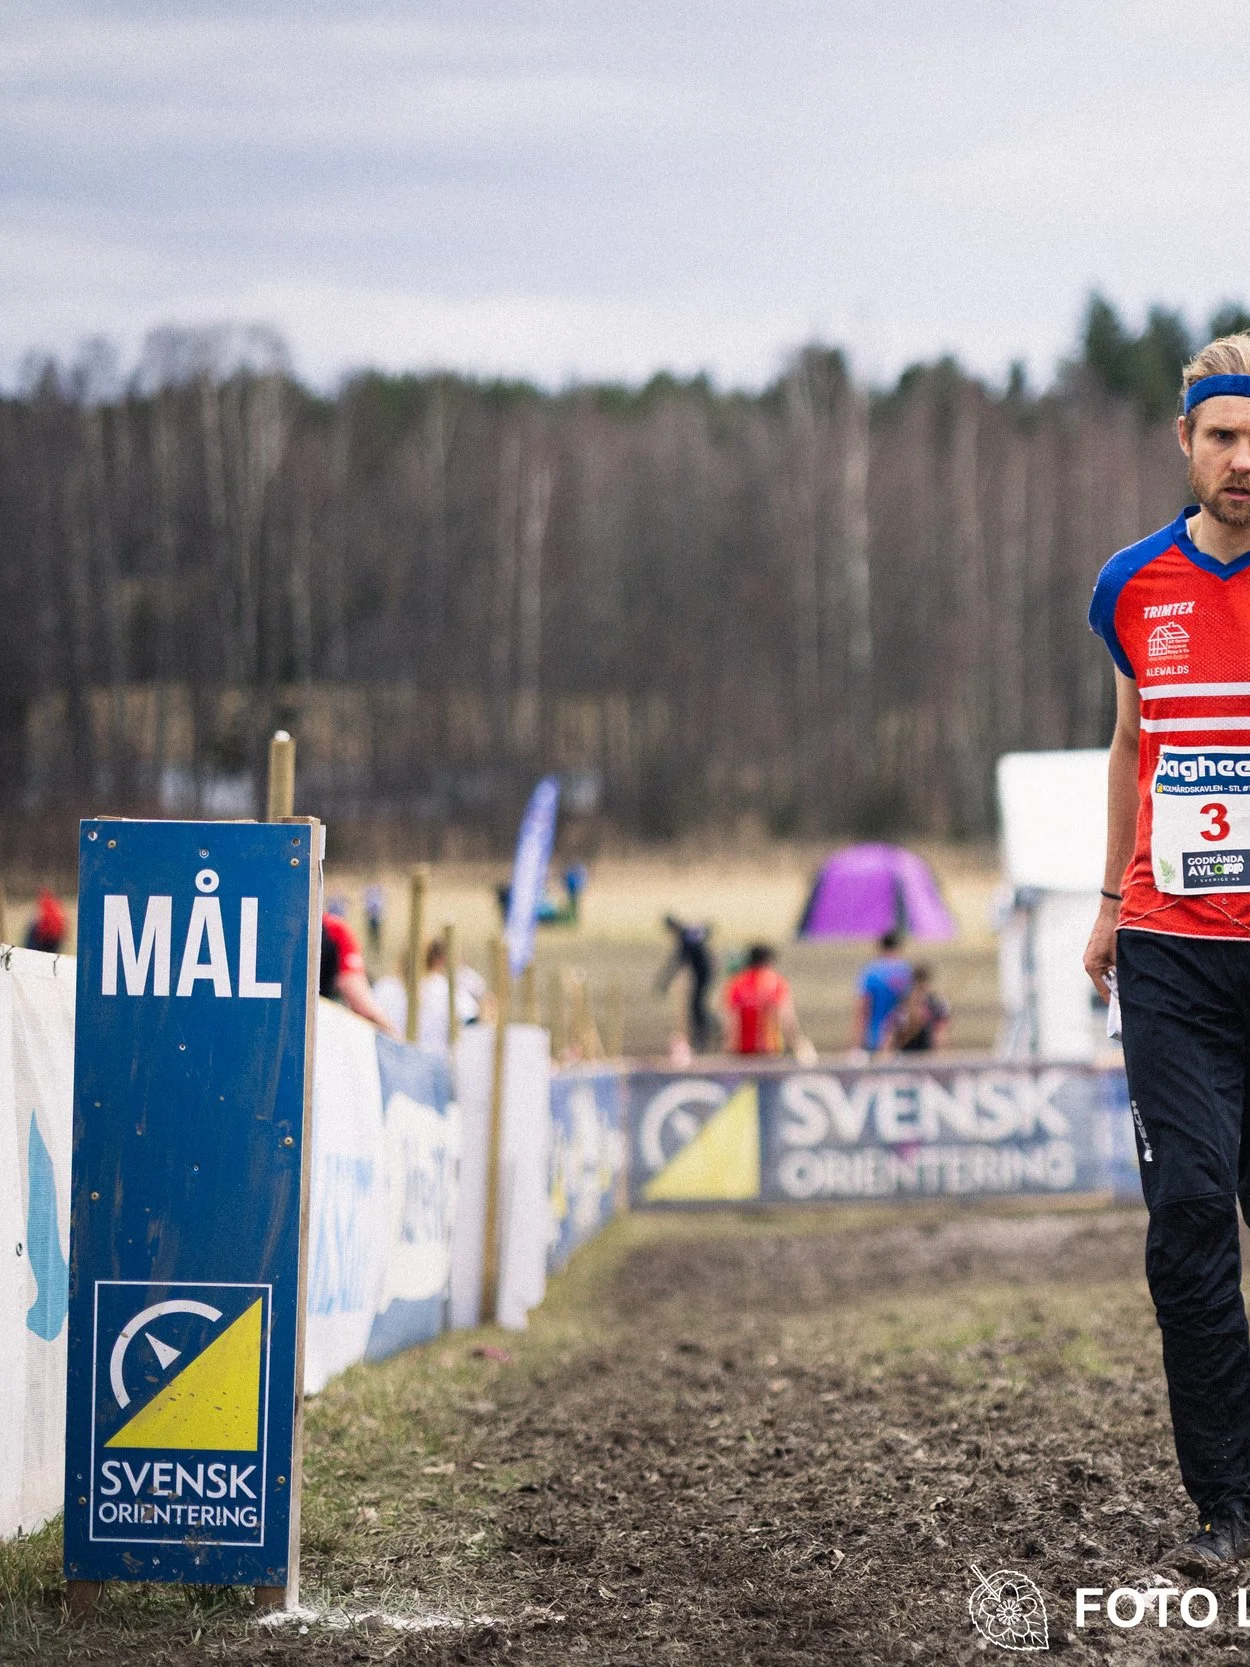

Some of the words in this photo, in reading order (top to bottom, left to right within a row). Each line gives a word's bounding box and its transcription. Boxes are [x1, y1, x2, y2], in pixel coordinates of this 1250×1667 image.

[1143, 601, 1195, 619] TRIMTEX
[1146, 665, 1189, 677] ALEWALDS
[1229, 784, 1242, 792] STL
[1200, 803, 1230, 841] 3
[1187, 854, 1245, 865] GODKÄNDA
[1188, 863, 1244, 876] AVLOPP
[102, 869, 281, 998] MÅL
[780, 1069, 1070, 1147] SVENSK
[777, 1141, 1076, 1199] ORIENTERING
[100, 1460, 257, 1499] SVENSK
[99, 1502, 258, 1527] ORIENTERING
